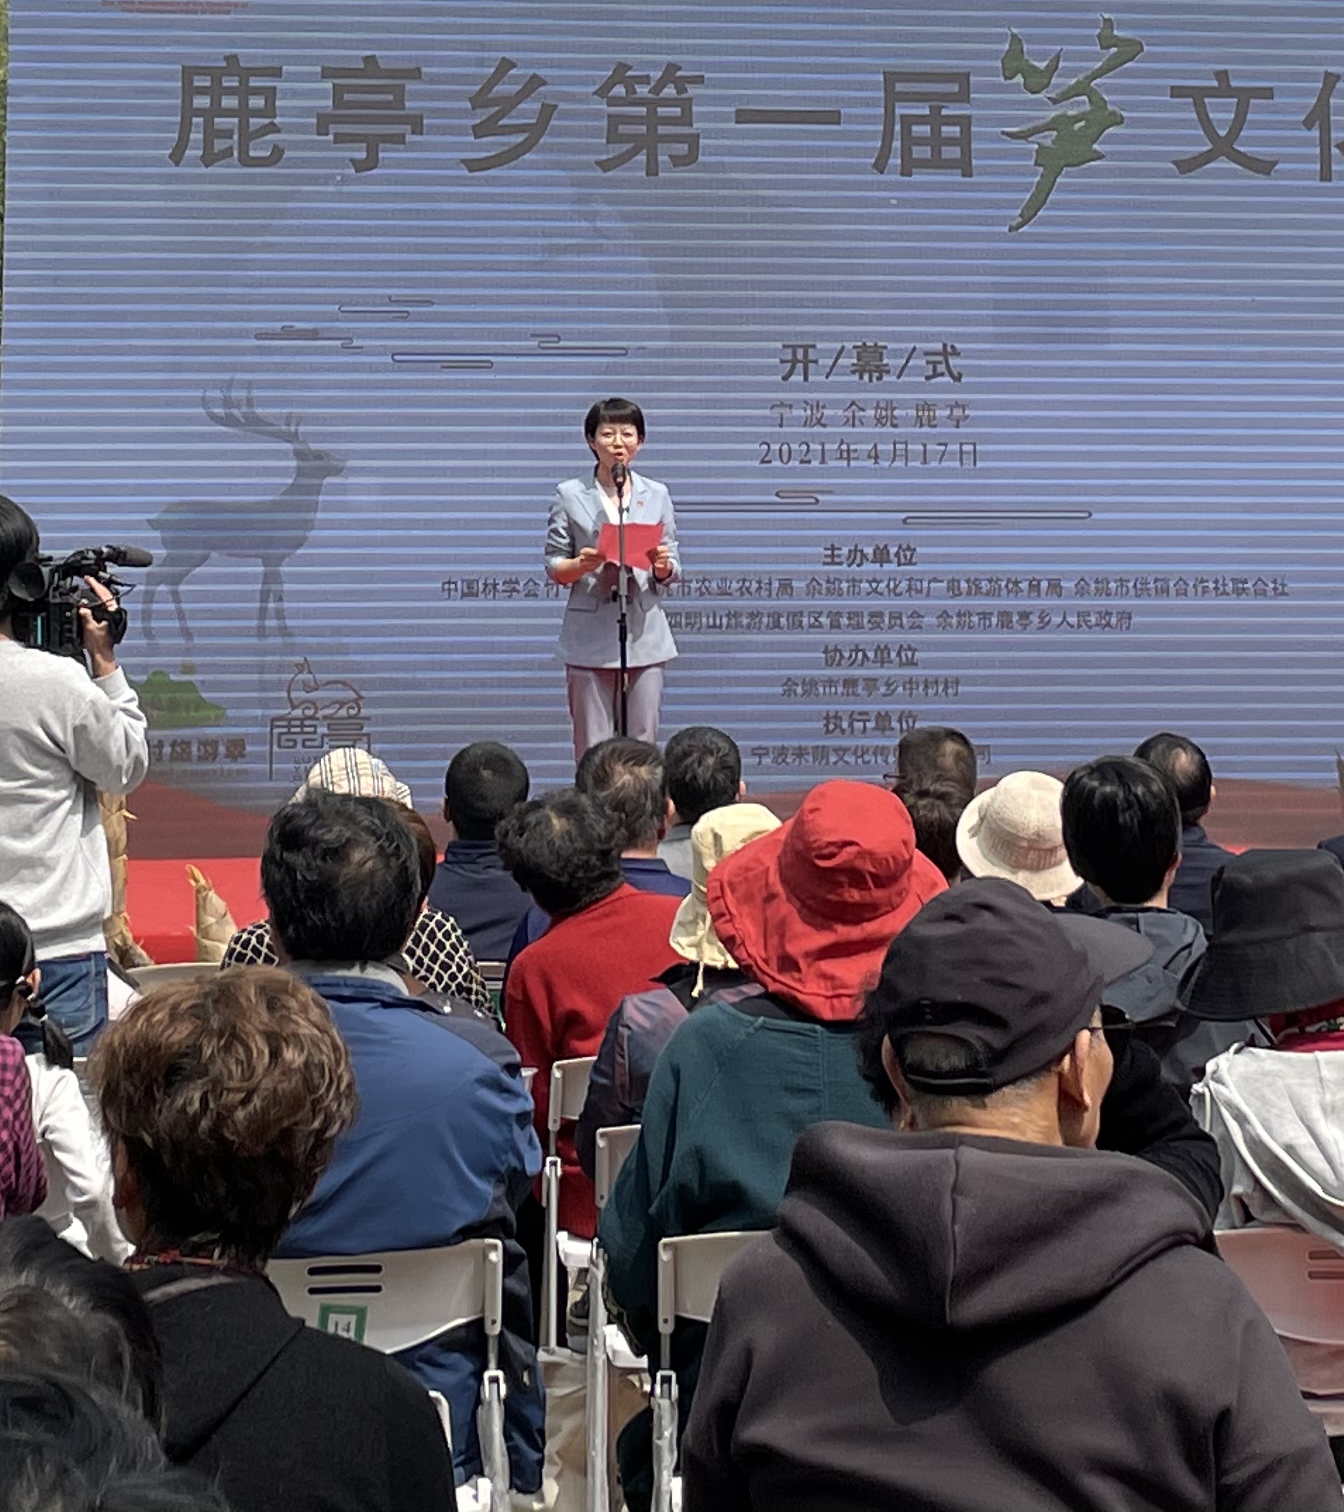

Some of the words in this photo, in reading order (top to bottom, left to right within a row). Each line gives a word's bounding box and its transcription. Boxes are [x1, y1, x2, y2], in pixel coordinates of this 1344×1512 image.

[779, 342, 963, 383] 开/幕/式
[758, 438, 978, 468] 2021年4月17日
[822, 543, 918, 568] 主办单位
[805, 575, 1063, 599] 余姚市文化和广电旅游体育局
[1073, 574, 1290, 599] 余姚市供销合作社联合社
[936, 608, 1133, 632] 余姚市鹿亭乡人民政府
[822, 643, 919, 668] 协办单位
[822, 710, 919, 735] 执行单位
